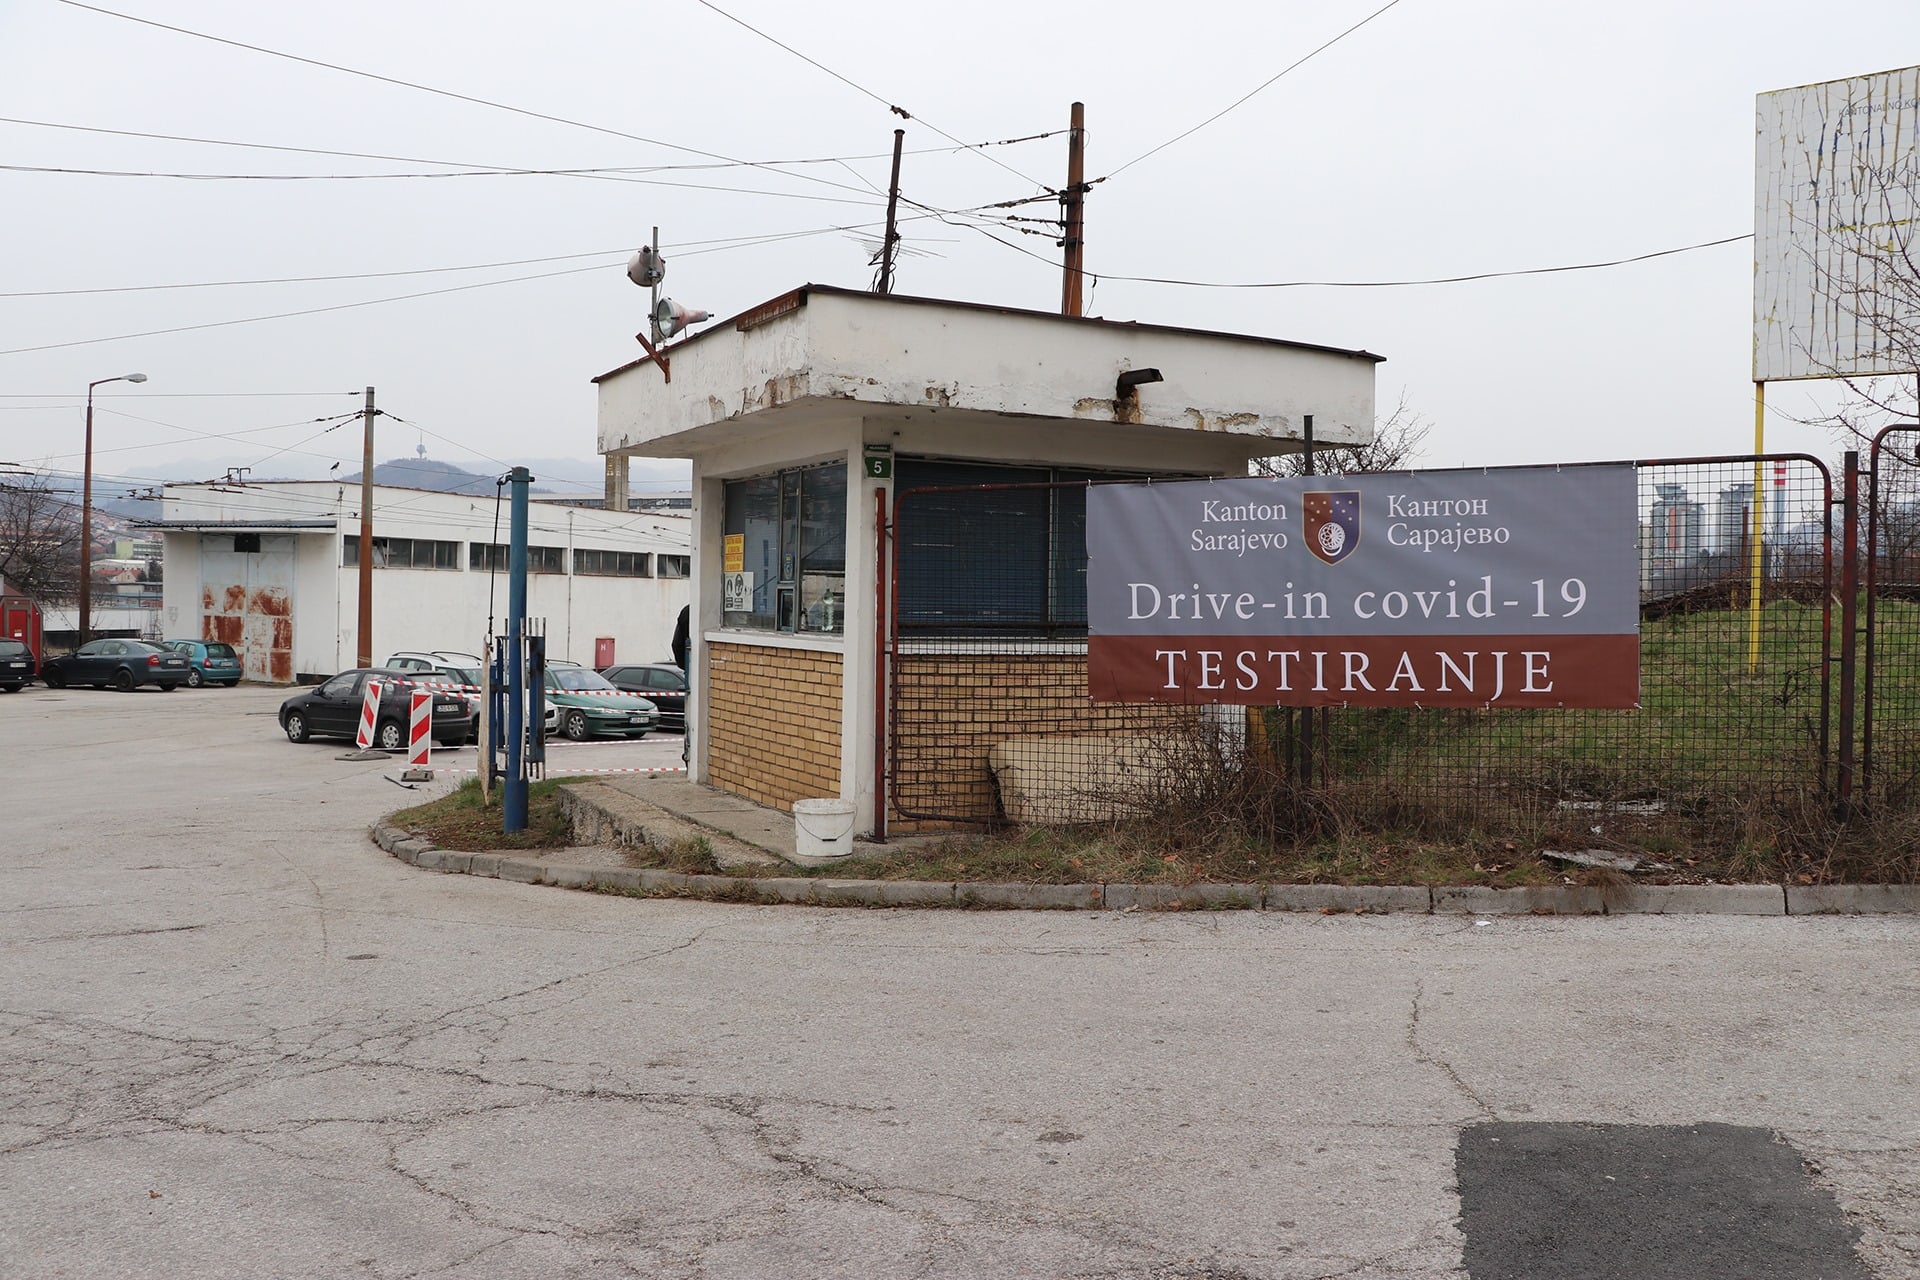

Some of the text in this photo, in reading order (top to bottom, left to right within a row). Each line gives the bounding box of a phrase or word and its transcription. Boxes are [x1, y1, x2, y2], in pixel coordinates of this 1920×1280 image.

[873, 460, 882, 474] 5
[1201, 500, 1288, 523] Kanton
[1386, 494, 1489, 518] Кантон
[1191, 528, 1288, 558] Sarajevo
[1387, 522, 1510, 553] Сарајево
[1127, 575, 1587, 620] Drive-in covid-19
[1155, 649, 1553, 700] TESTIRANJE
